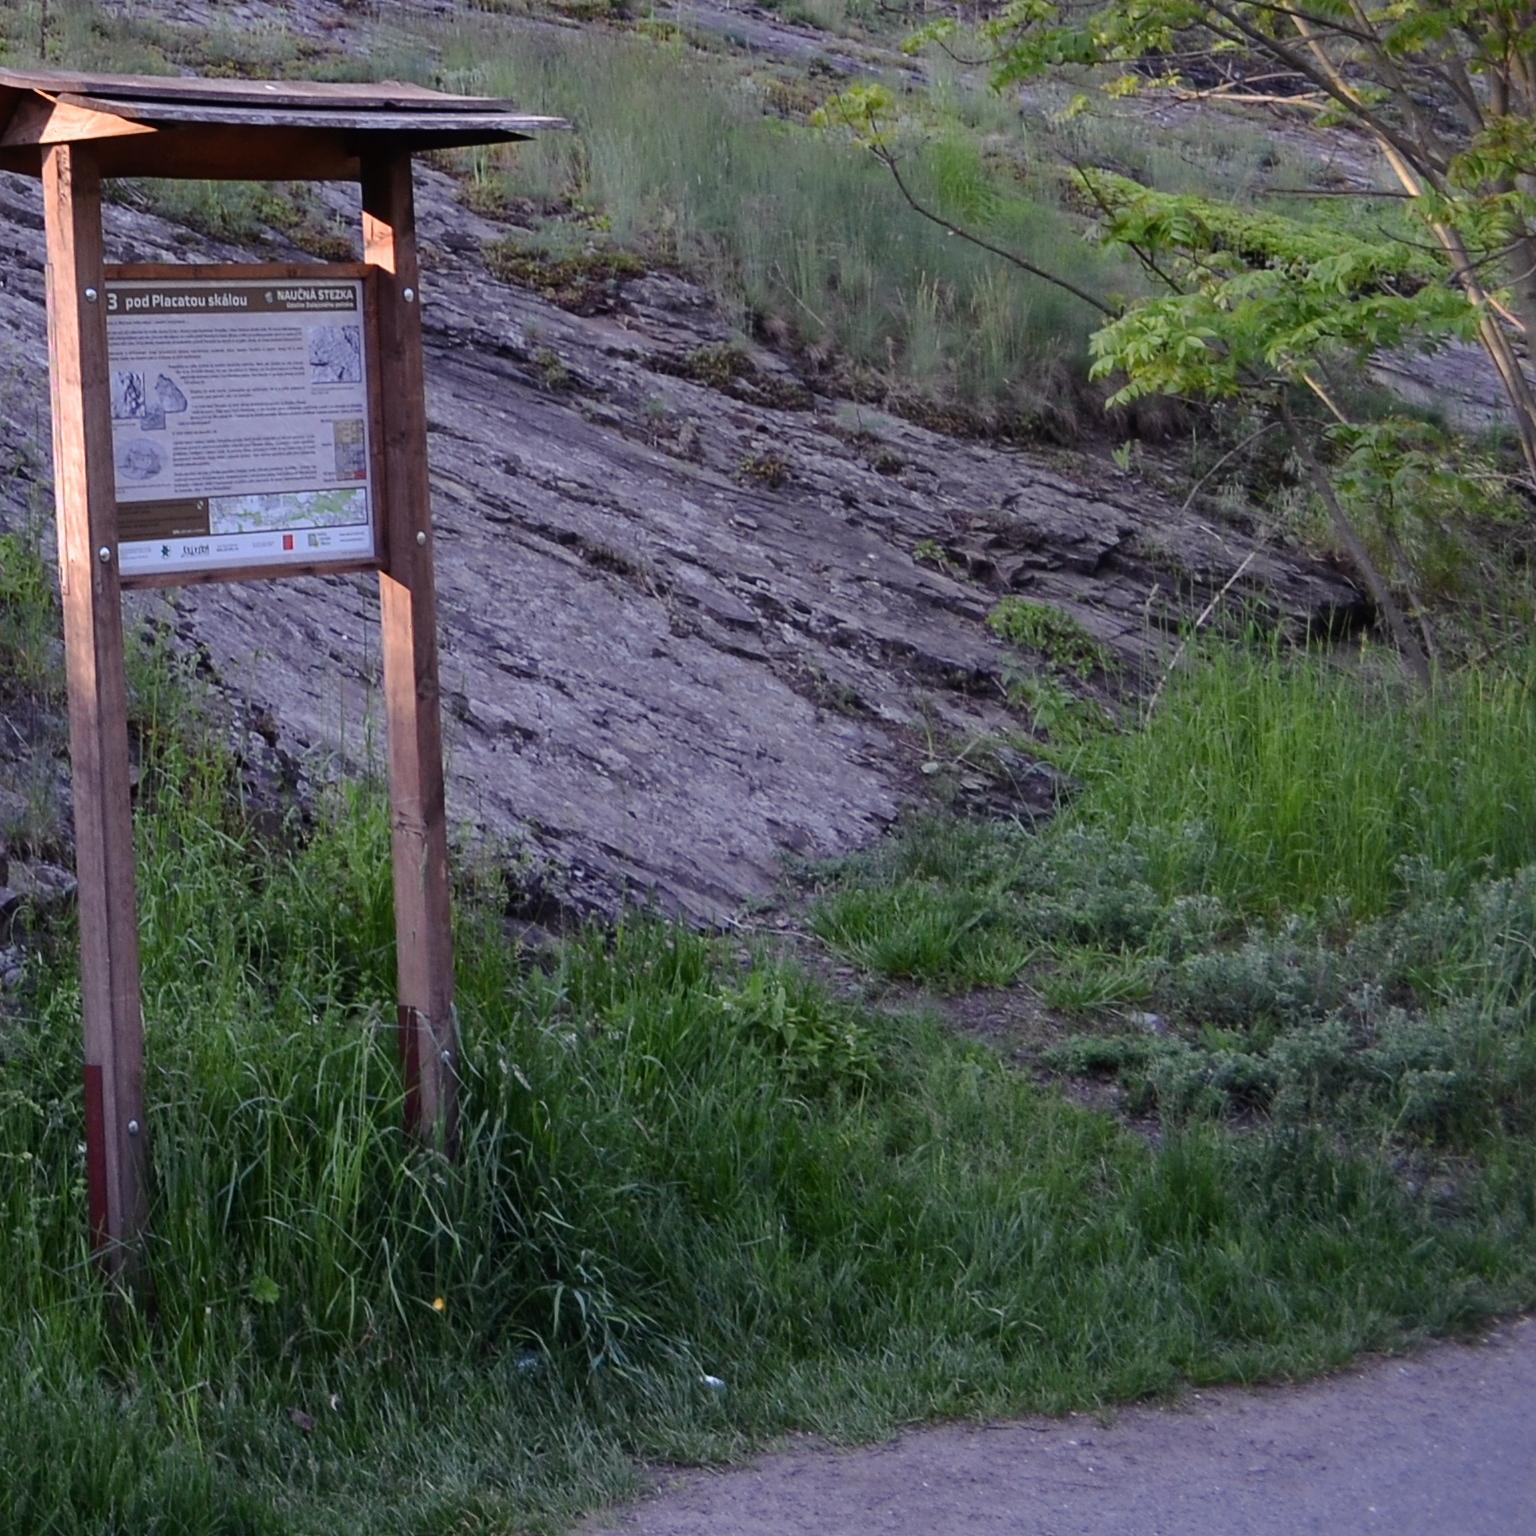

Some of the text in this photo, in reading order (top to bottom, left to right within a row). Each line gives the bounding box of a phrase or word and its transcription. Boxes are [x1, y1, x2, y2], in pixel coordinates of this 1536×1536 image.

[107, 291, 248, 311] 3 pod Placatou skálou
[276, 287, 354, 301] NAUČNÁ STEZKA
